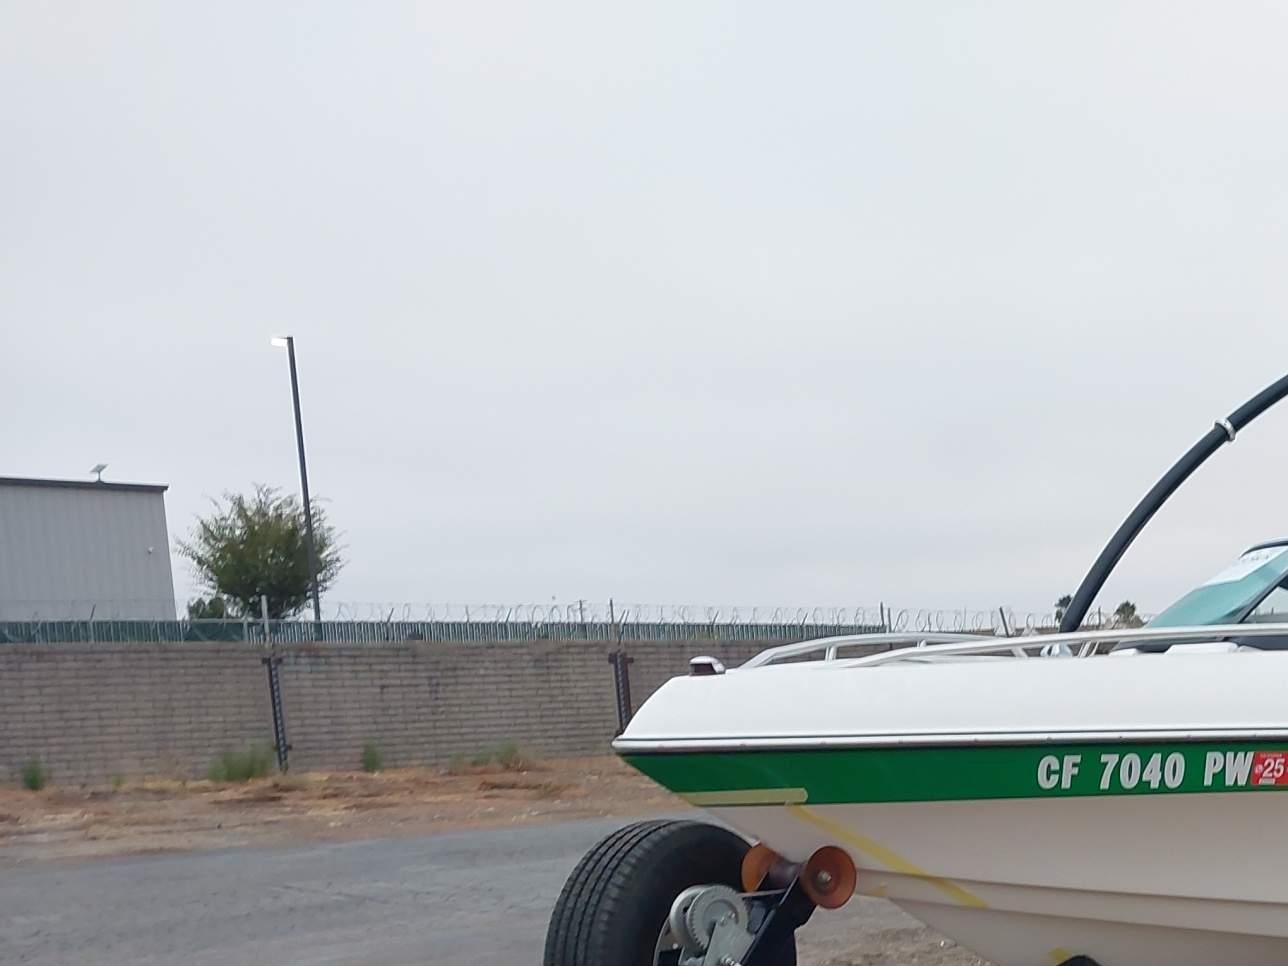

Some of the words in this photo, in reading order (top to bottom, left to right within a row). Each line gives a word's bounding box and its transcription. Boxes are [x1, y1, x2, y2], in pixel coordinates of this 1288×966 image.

[1037, 755, 1081, 789] CF
[1100, 752, 1185, 789] 7040
[1203, 751, 1254, 786] PW
[1263, 758, 1285, 778] 25
